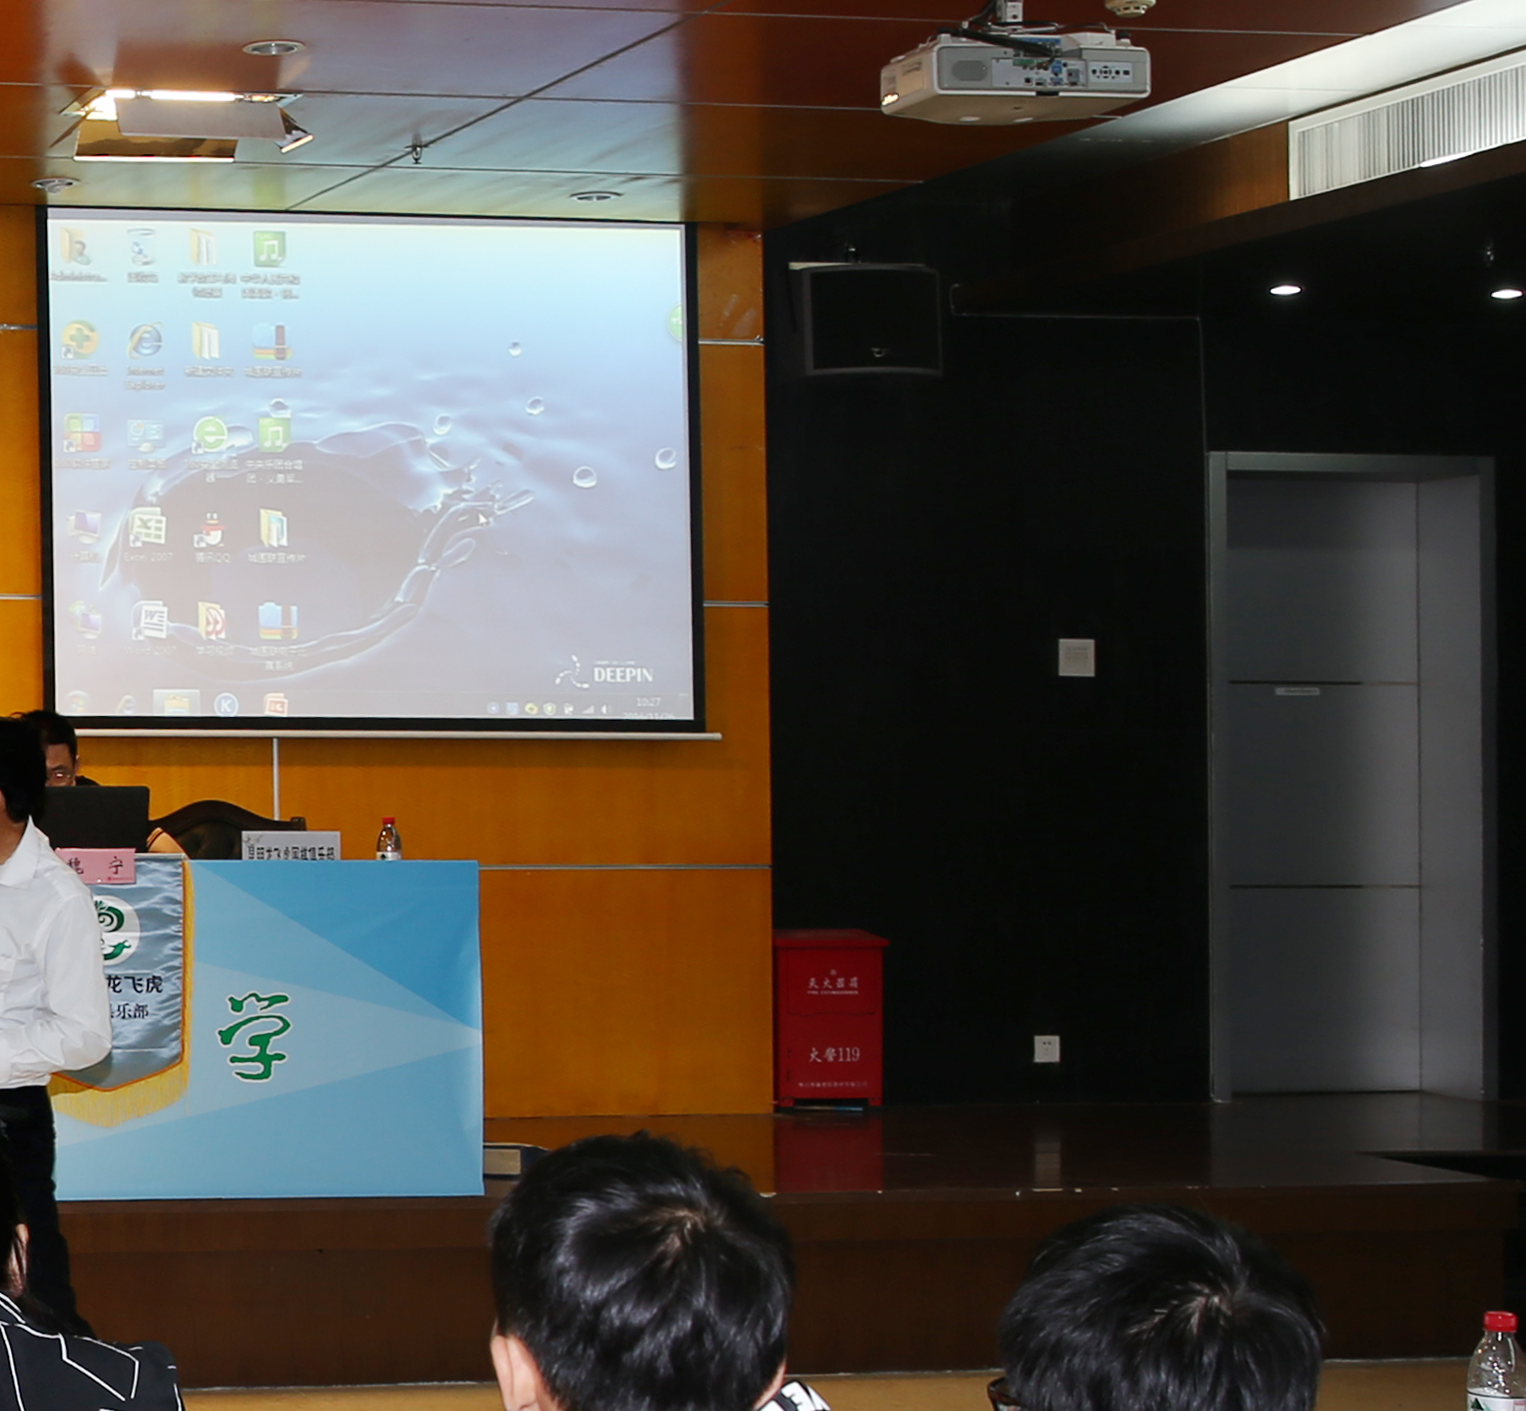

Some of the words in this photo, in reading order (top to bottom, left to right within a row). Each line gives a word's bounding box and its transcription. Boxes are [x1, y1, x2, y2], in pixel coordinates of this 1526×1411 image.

[593, 667, 653, 682] DEEPIN
[110, 1003, 149, 1019] 乐部
[216, 992, 292, 1082] 学
[809, 1047, 861, 1063] 火警119
